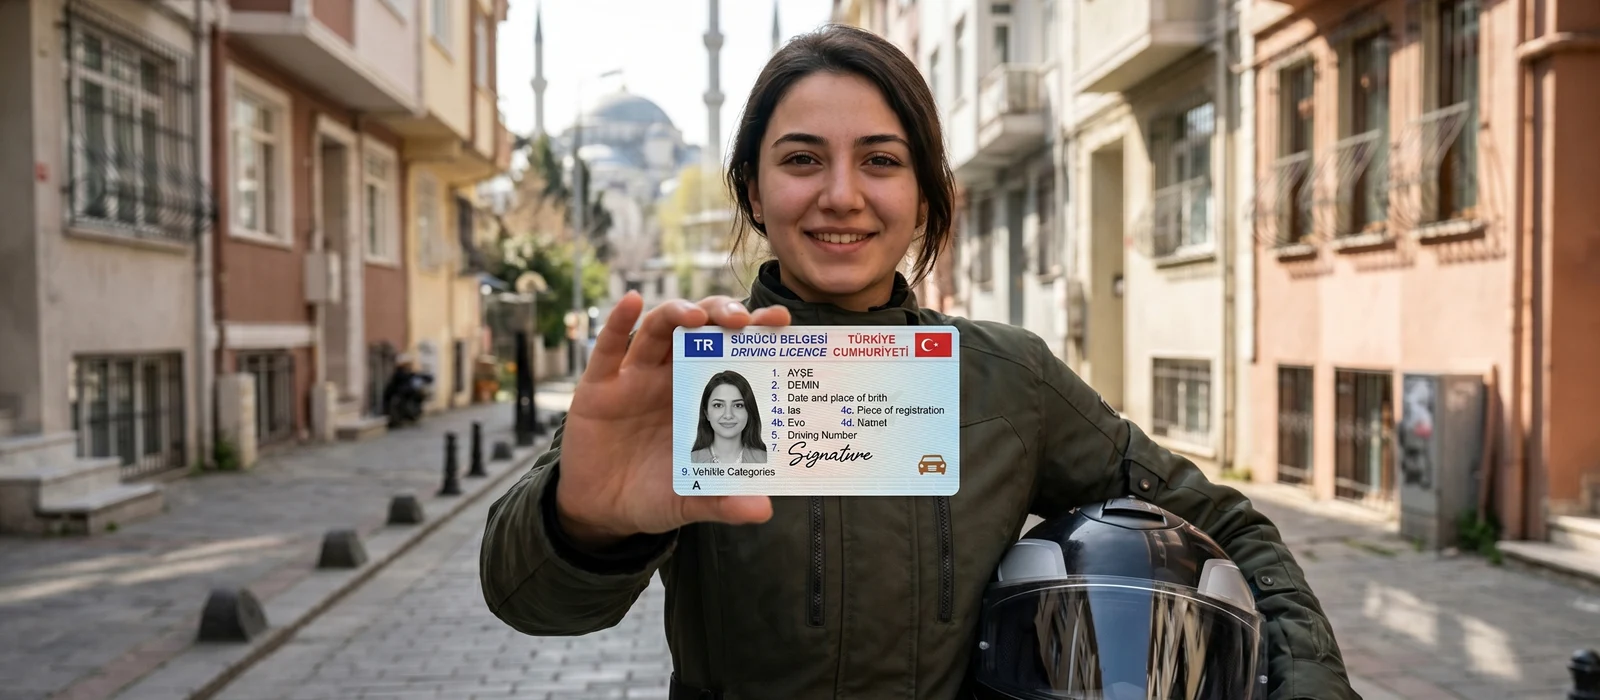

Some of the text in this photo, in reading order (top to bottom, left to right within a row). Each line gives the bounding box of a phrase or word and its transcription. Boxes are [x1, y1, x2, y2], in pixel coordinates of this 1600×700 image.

[731, 333, 828, 344] SÜRÜCÜ BELGESİ
[848, 333, 896, 344] TÜRKİYE
[694, 339, 714, 351] TR
[731, 348, 827, 357] DRIVING LICENCE
[833, 346, 909, 357] CUMHURİYETİ
[772, 369, 814, 378] 1. AYŞE
[771, 381, 820, 390] 2. DEMIN
[771, 394, 888, 404] 3. Date and place of brith
[771, 406, 785, 415] 4a.
[840, 406, 945, 416] 4c. Piece of registration
[771, 418, 806, 427] 4b. Evo
[840, 418, 855, 427] 4d.
[771, 431, 857, 441] 5. Driving Number
[771, 441, 873, 468] 7. Signature
[681, 468, 690, 476] 9.
[727, 467, 776, 478] Categories
[692, 480, 701, 490] A
